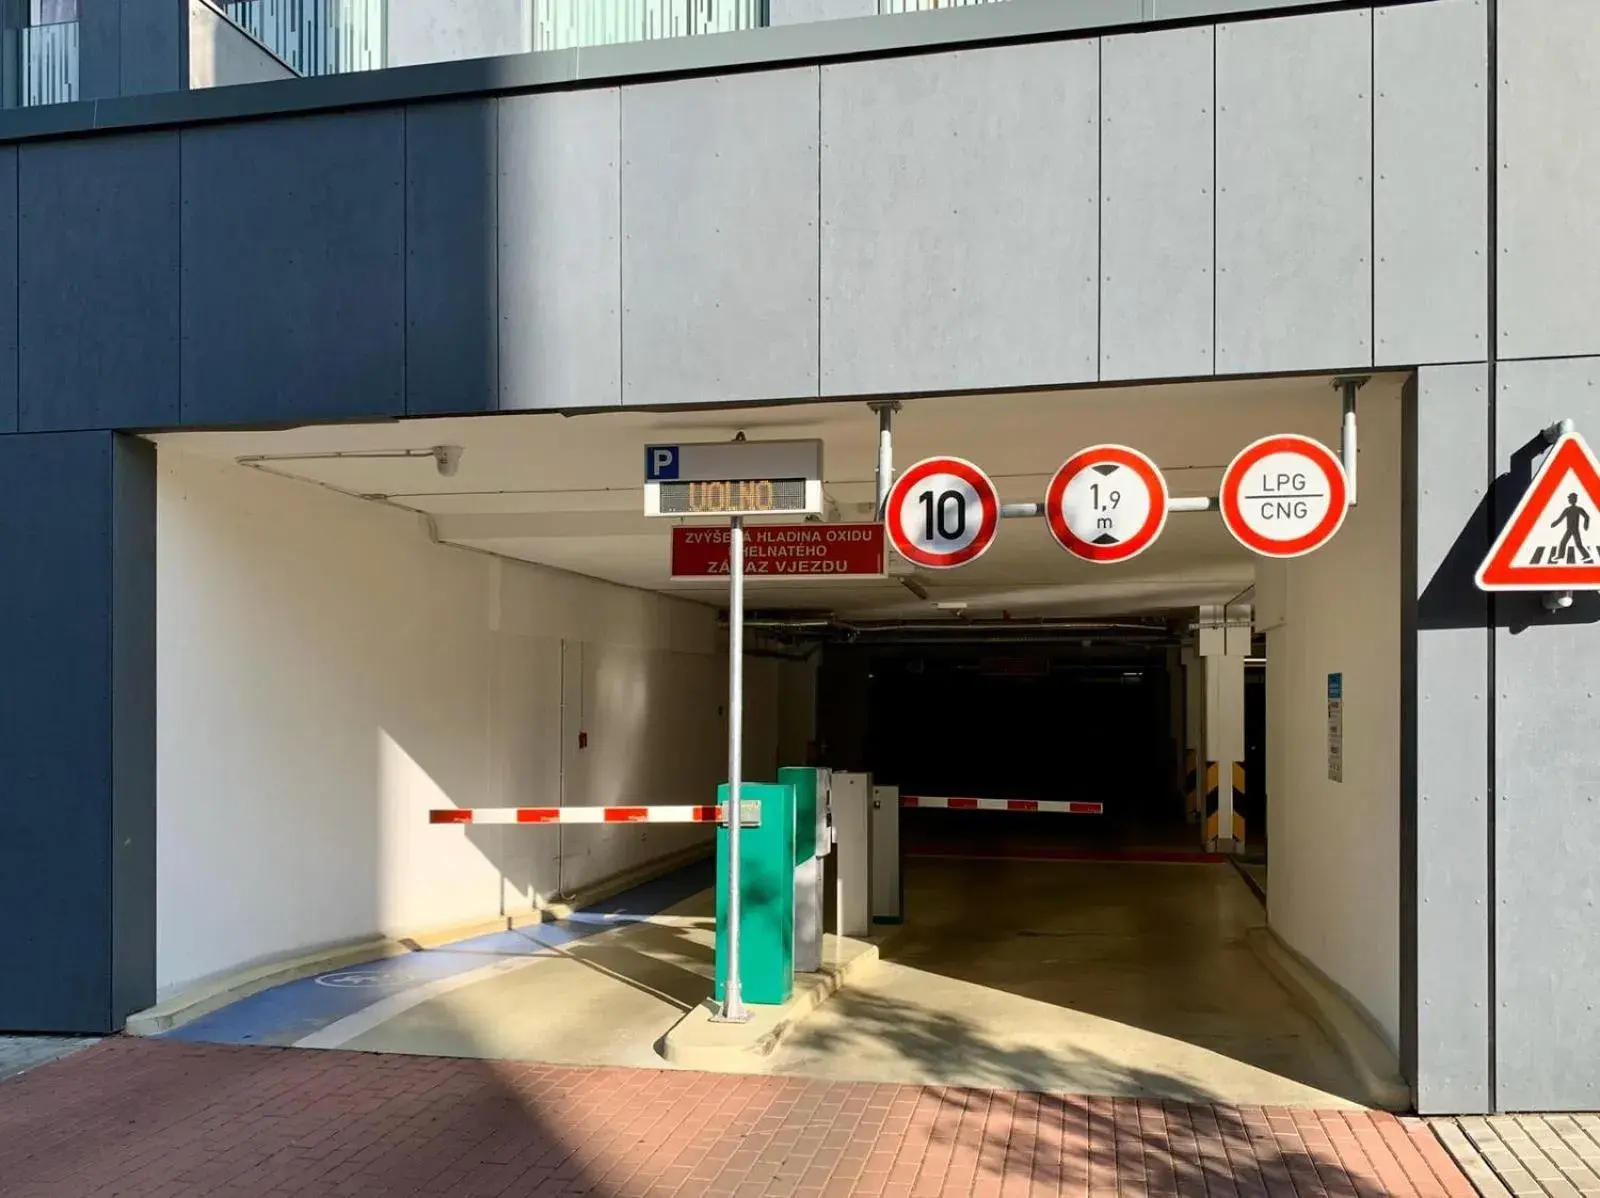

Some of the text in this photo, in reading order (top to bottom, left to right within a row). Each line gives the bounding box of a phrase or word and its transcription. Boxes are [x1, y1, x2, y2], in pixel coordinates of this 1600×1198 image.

[654, 449, 673, 475] P
[1263, 473, 1306, 491] LPG
[1090, 483, 1120, 511] 1,9
[918, 489, 966, 540] 10
[1261, 501, 1308, 519] CNG
[1097, 517, 1112, 529] m
[685, 529, 872, 544] ZVÝŠEÁ HLADINA OXIDU
[729, 543, 828, 557] HELNATÉHO
[707, 558, 848, 574] ZÁAZ VJEZDU
